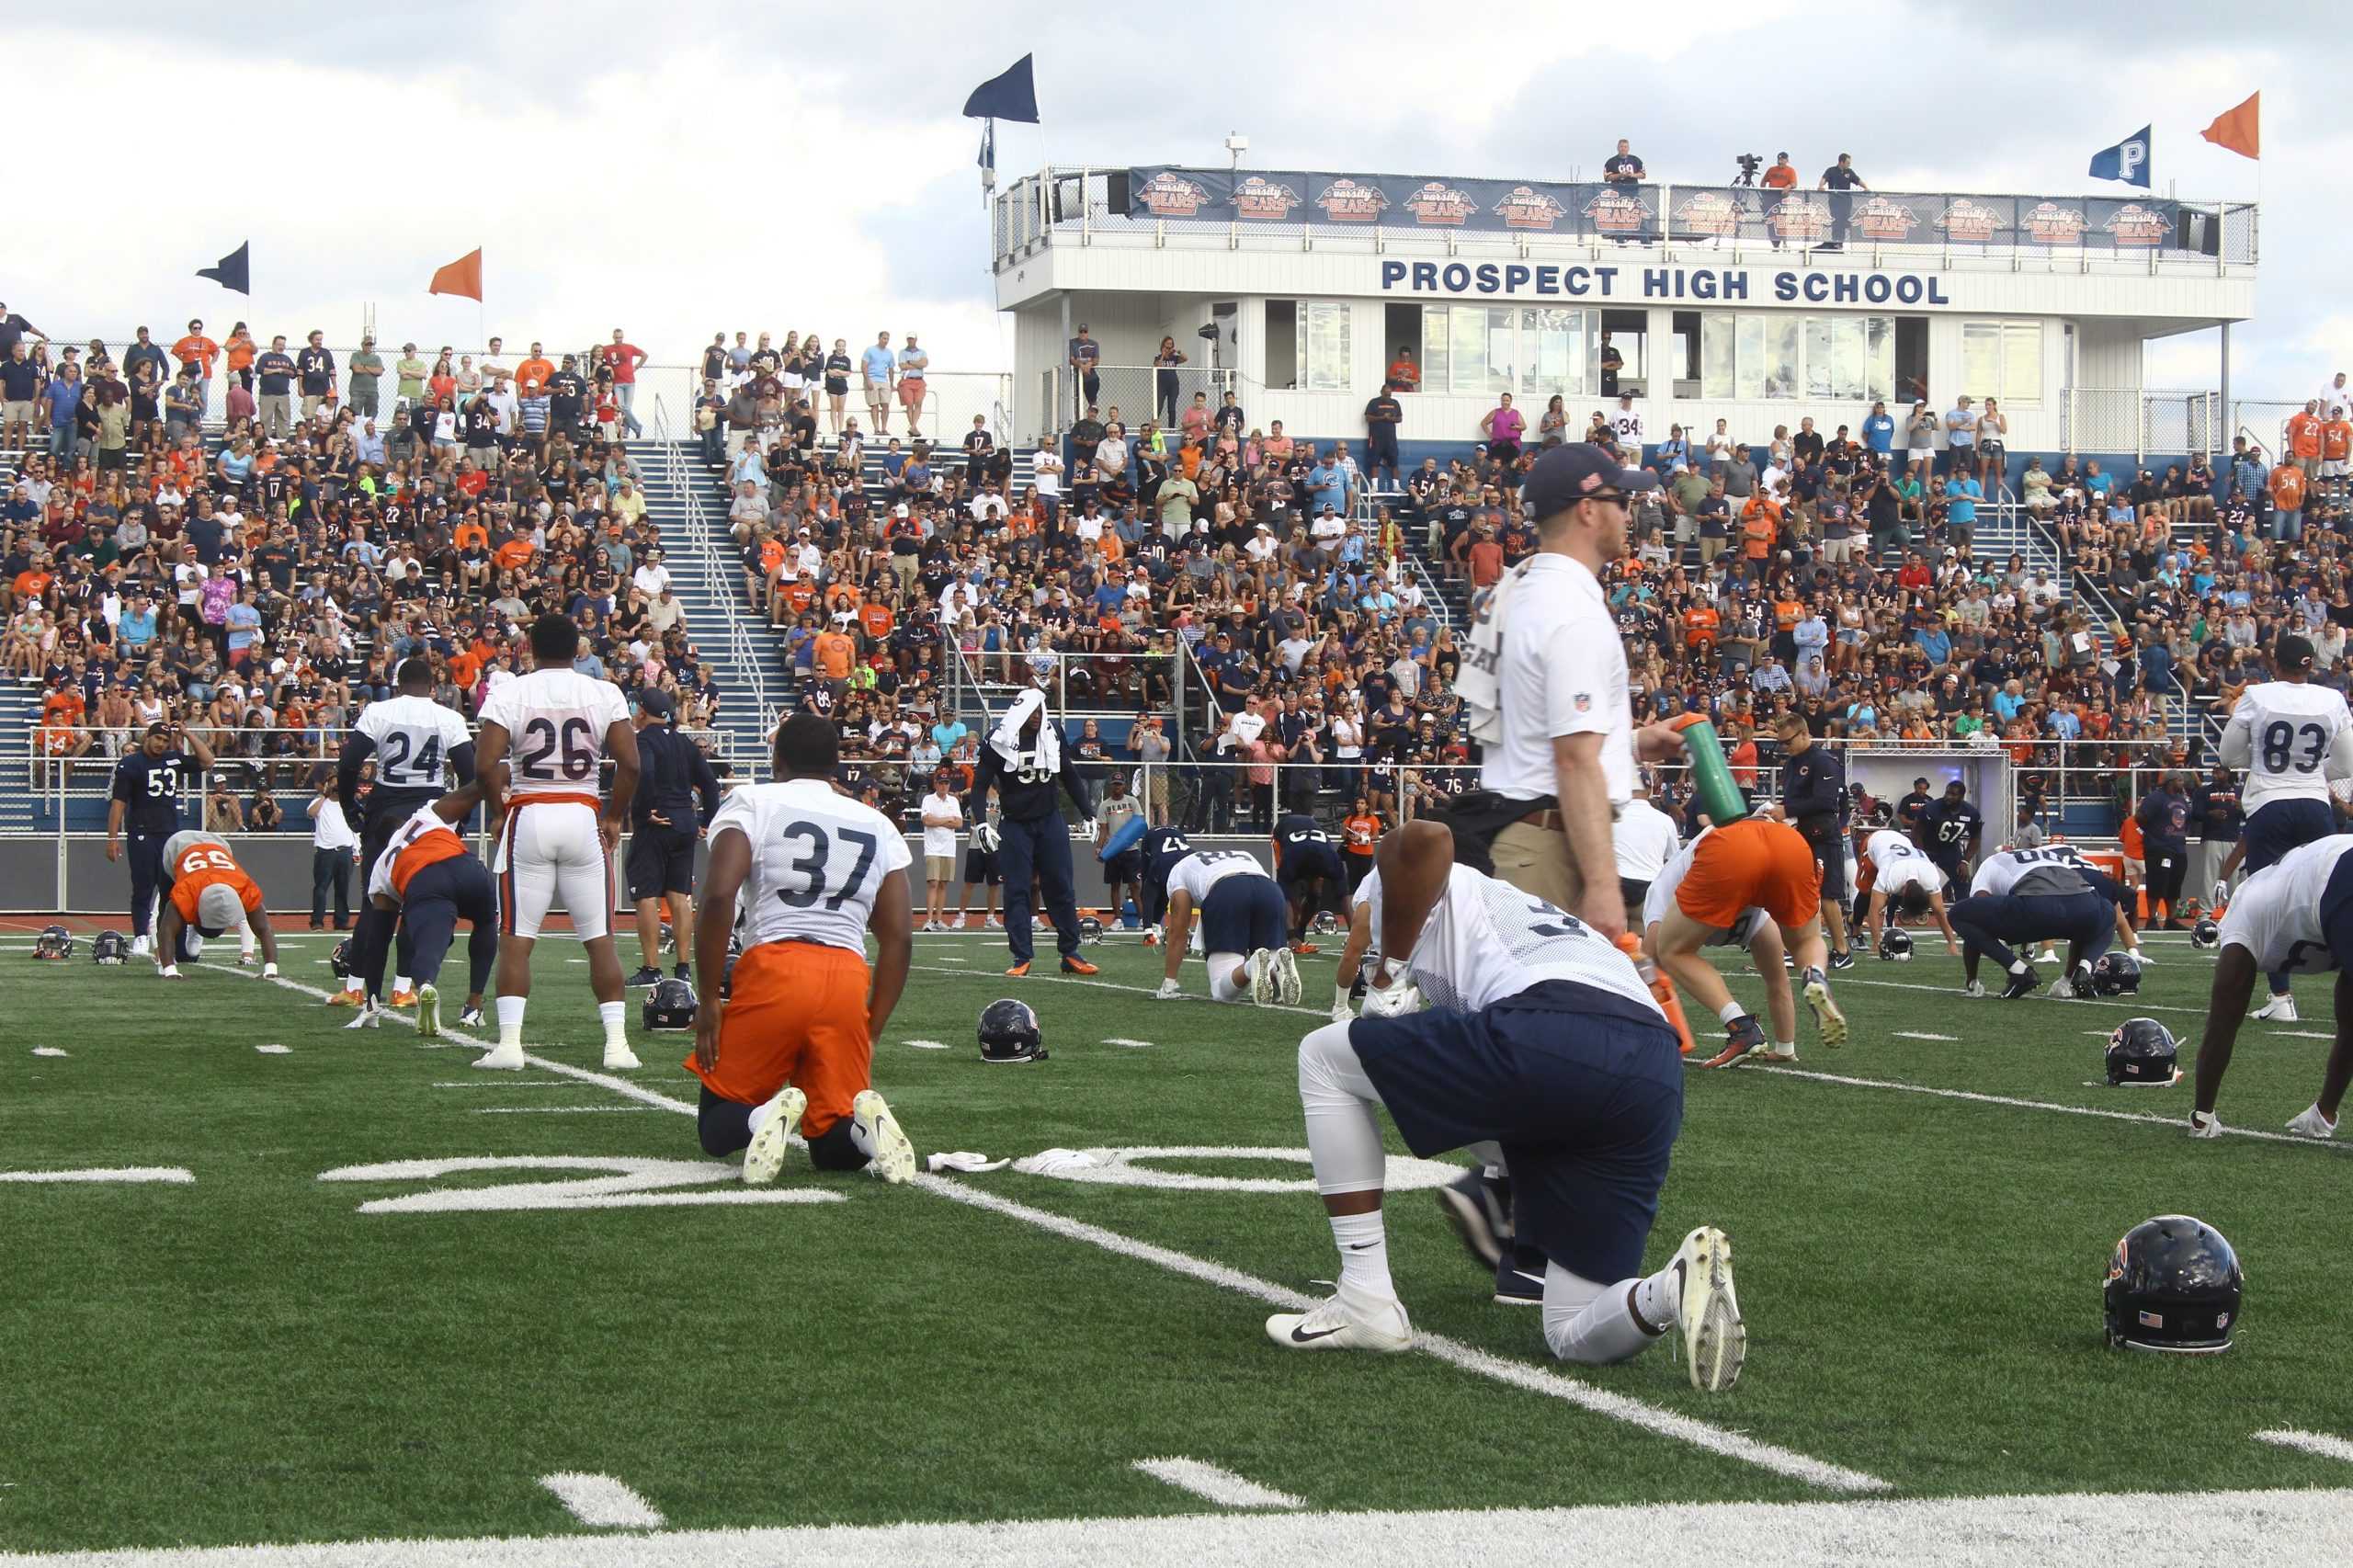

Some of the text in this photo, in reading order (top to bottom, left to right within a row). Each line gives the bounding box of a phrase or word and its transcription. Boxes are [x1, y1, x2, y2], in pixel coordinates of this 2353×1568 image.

[2120, 140, 2146, 180] P
[1154, 182, 1192, 196] varsity
[1245, 187, 1282, 199] varsity
[1333, 188, 1373, 203] varsity
[1151, 192, 1197, 208] BEARS
[1240, 196, 1287, 211] BEARS
[1422, 191, 1461, 205] varsity
[1512, 195, 1550, 210] varsity
[1598, 199, 1637, 211] varsity
[1329, 199, 1377, 214] BEARS
[1418, 201, 1466, 217] BEARS
[1507, 206, 1552, 221] BEARS
[1867, 207, 1904, 220] varsity
[1597, 209, 1641, 224] BEARS
[1952, 210, 1987, 222] varsity
[2035, 211, 2074, 223] varsity
[2119, 213, 2158, 226] varsity
[1863, 217, 1907, 232] BEARS
[1948, 218, 1993, 233] BEARS
[2032, 221, 2079, 236] BEARS
[2117, 222, 2162, 238] BEARS
[1381, 261, 1949, 304] PROSPECT HIGH SCHOOL
[307, 357, 324, 373] 34
[475, 414, 490, 430] 34
[1619, 418, 1638, 436] 34
[2303, 422, 2318, 437] 23
[974, 437, 983, 449] 17
[2329, 430, 2341, 443] 54
[2281, 474, 2296, 489] 54
[269, 483, 279, 497] 17
[386, 507, 399, 523] 22
[2228, 510, 2245, 524] 23
[80, 585, 91, 597] 17
[1745, 605, 1763, 619] 54
[523, 717, 593, 780] 26
[2263, 721, 2326, 774] 83
[383, 731, 440, 784] 24
[148, 767, 176, 797] 53
[847, 769, 859, 782] 17
[1444, 779, 1462, 794] 76
[1107, 803, 1133, 812] BEARS
[1938, 821, 1965, 843] 67
[777, 821, 877, 911] 37
[317, 1154, 849, 1213] 2
